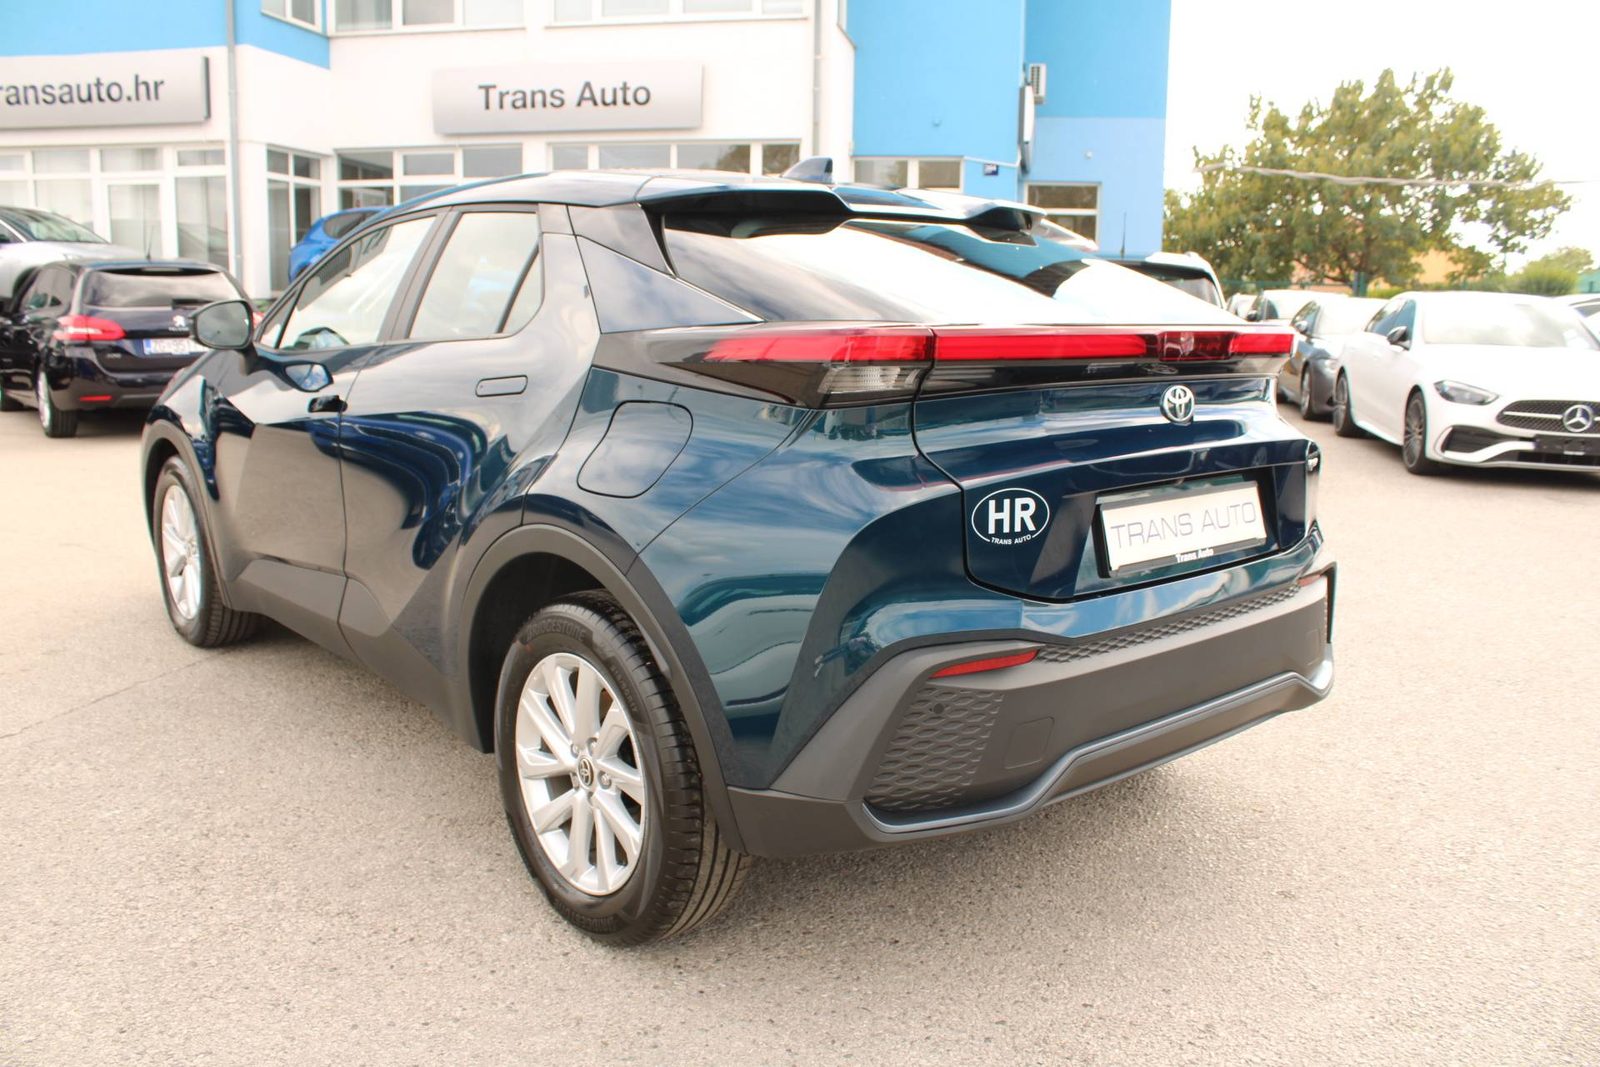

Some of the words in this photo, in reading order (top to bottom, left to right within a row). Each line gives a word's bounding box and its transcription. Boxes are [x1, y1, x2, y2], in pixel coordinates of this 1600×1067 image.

[0, 74, 165, 106] ansauto.hr
[478, 84, 566, 111] Trans
[575, 80, 652, 107] Auto
[988, 497, 1037, 535] HR
[1110, 512, 1194, 549] TRANS
[1201, 501, 1257, 534] AUTO
[991, 536, 1012, 545] TRANS
[1014, 534, 1032, 544] AUTO
[1175, 552, 1197, 563] Trans
[1197, 548, 1214, 559] Auto
